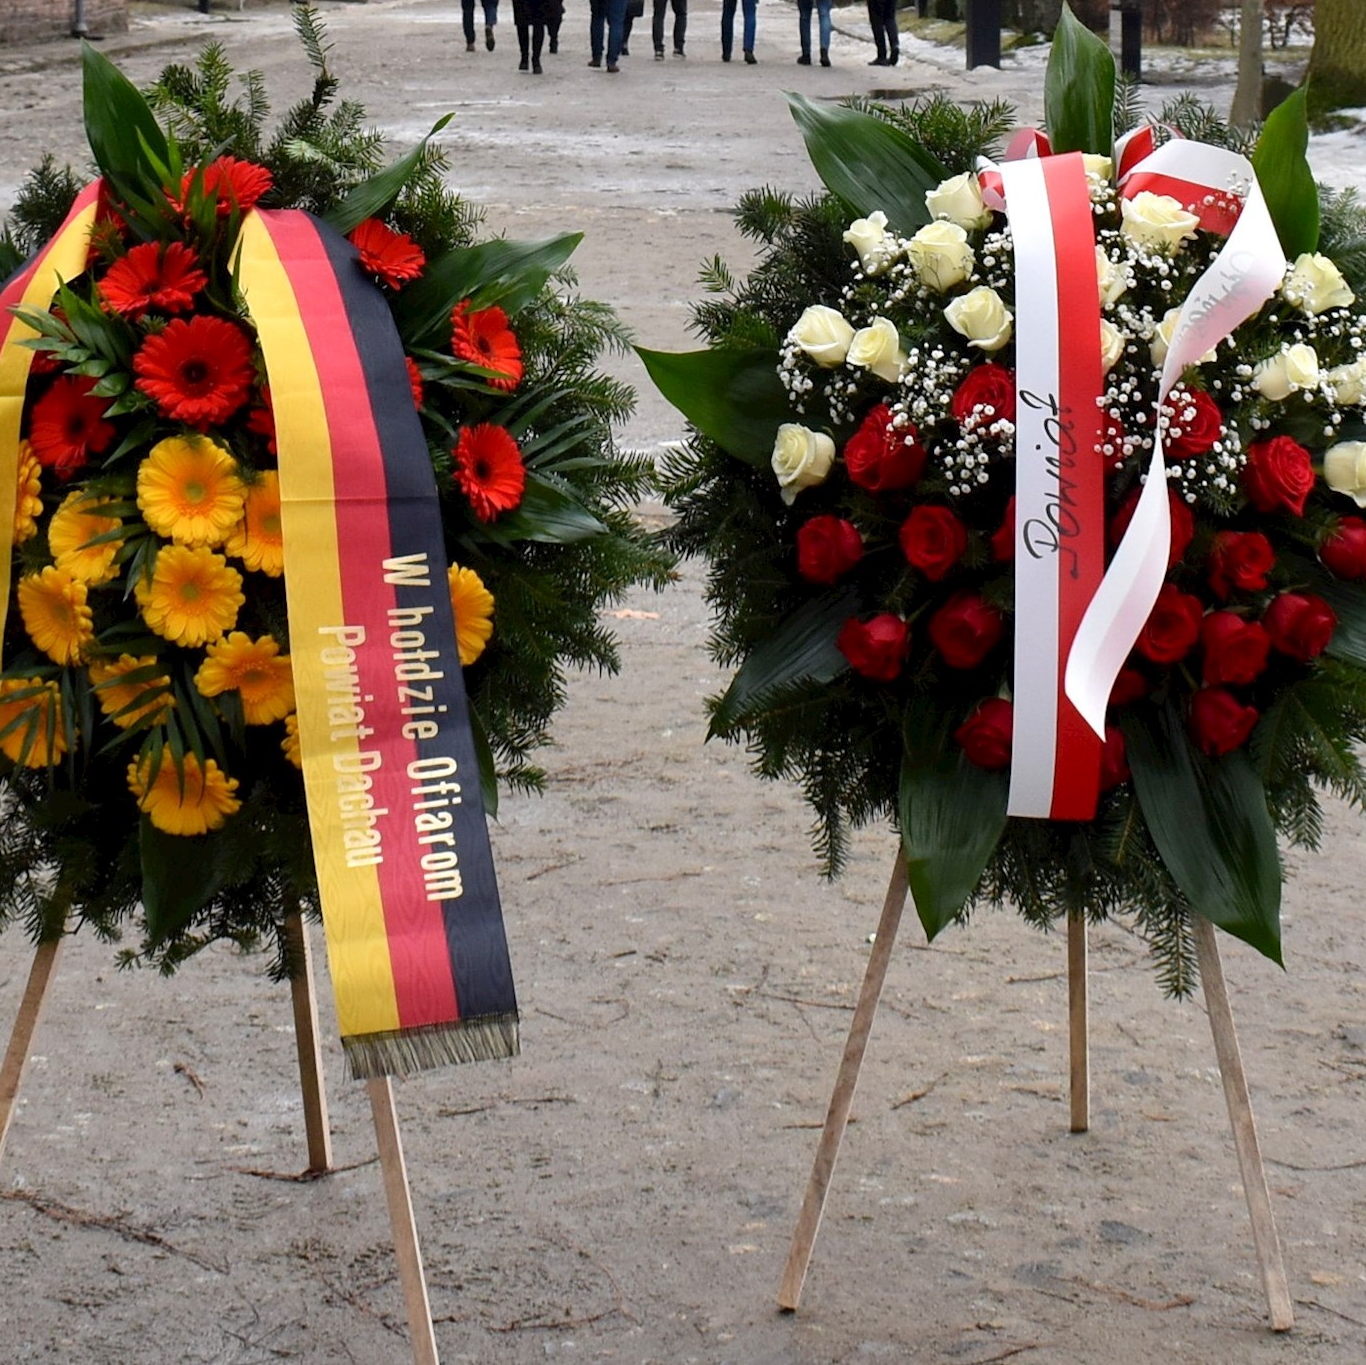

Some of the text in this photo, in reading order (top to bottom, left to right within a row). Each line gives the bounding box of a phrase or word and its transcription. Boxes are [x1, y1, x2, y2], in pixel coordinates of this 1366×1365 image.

[1019, 389, 1081, 581] Powiat
[318, 624, 389, 869] Powiat Dachau
[382, 552, 464, 902] W hołdzie Ofiarom
